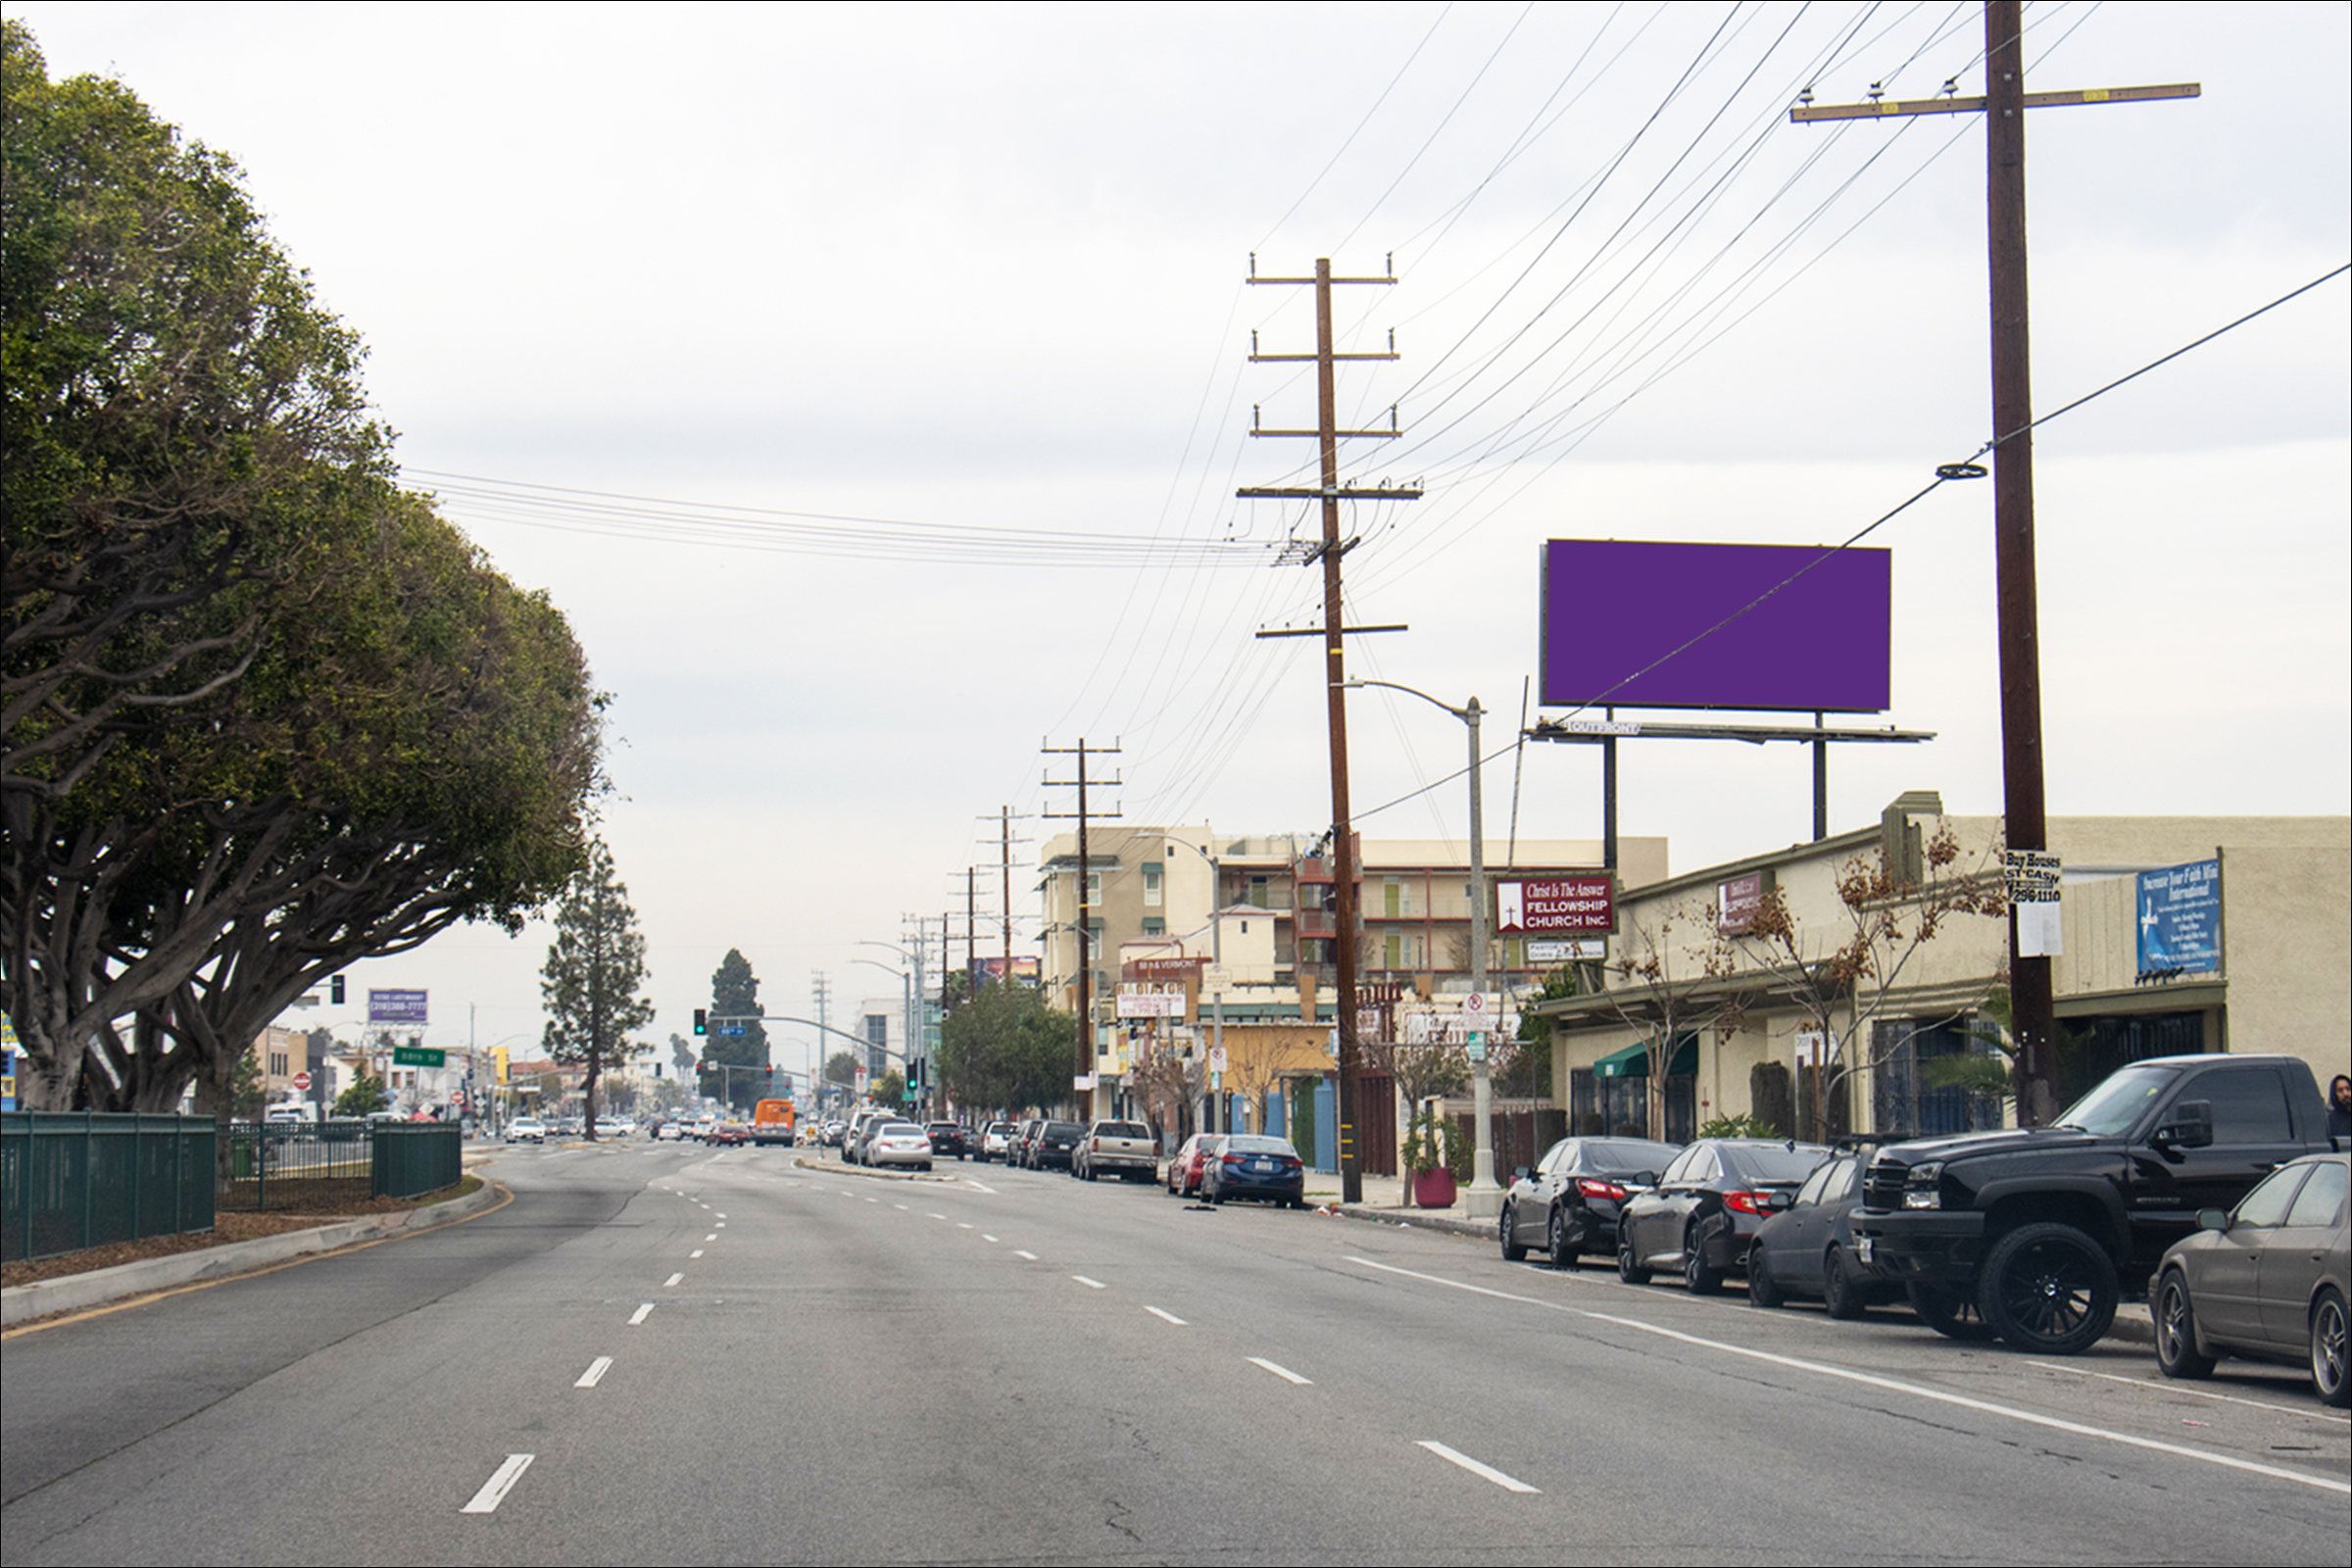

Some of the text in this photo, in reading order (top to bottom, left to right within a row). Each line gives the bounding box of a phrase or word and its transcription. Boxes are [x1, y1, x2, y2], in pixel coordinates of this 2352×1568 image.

[1572, 721, 1638, 733] OUTFRONT
[2006, 852, 2061, 869] Buy Houses
[2026, 868, 2060, 884] CASH
[2184, 865, 2202, 883] Faith
[1527, 882, 1606, 899] Christ Is The Answer
[1527, 900, 1608, 913] FELLOWSHIP
[1526, 915, 1583, 928] CHURCH
[1160, 958, 1197, 969] VERMONT
[1117, 982, 1185, 995] RADIATOR
